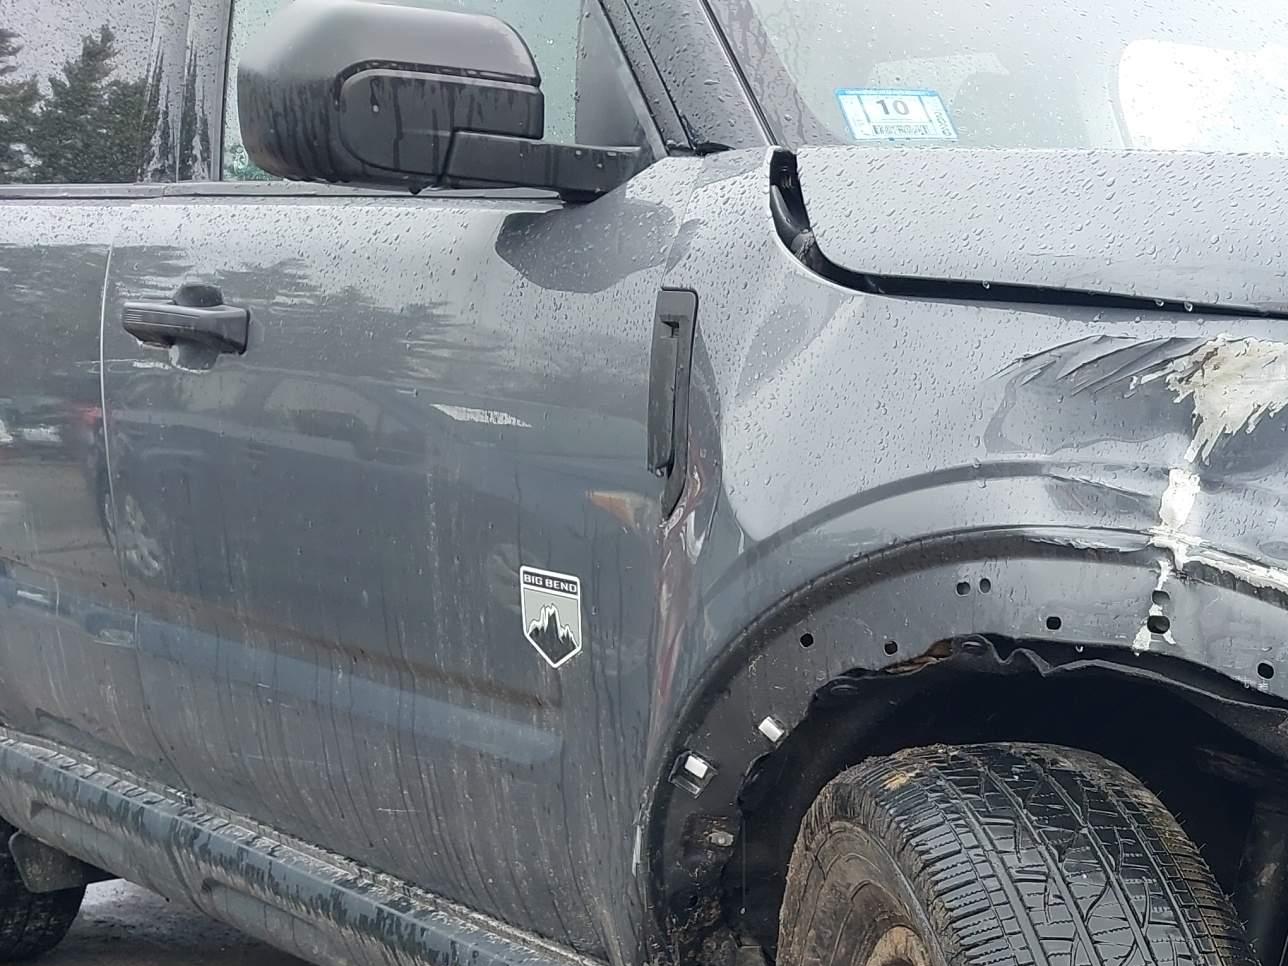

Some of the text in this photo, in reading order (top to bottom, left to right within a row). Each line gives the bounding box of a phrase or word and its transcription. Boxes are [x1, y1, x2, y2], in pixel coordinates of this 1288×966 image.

[876, 100, 909, 115] 10
[524, 574, 577, 592] BIG BEND
